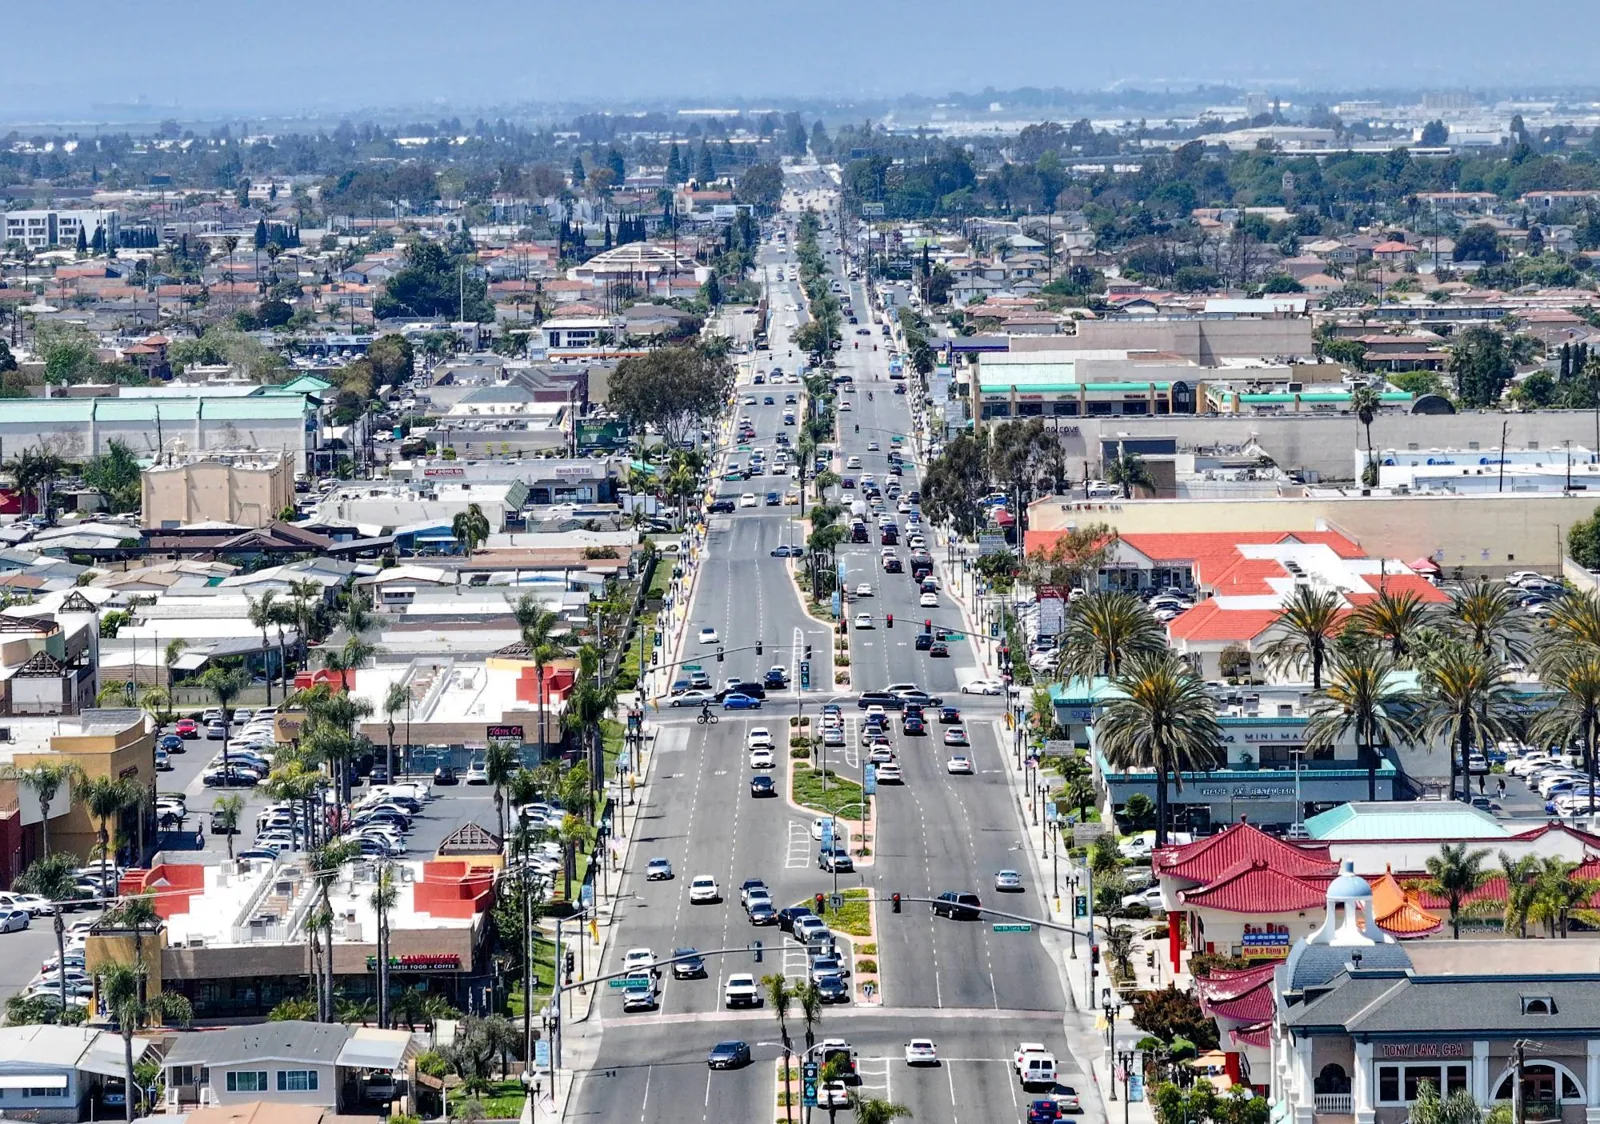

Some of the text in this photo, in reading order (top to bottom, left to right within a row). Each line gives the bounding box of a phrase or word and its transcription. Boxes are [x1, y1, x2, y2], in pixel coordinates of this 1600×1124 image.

[1383, 1044, 1464, 1057] TONY LAM, CPA
